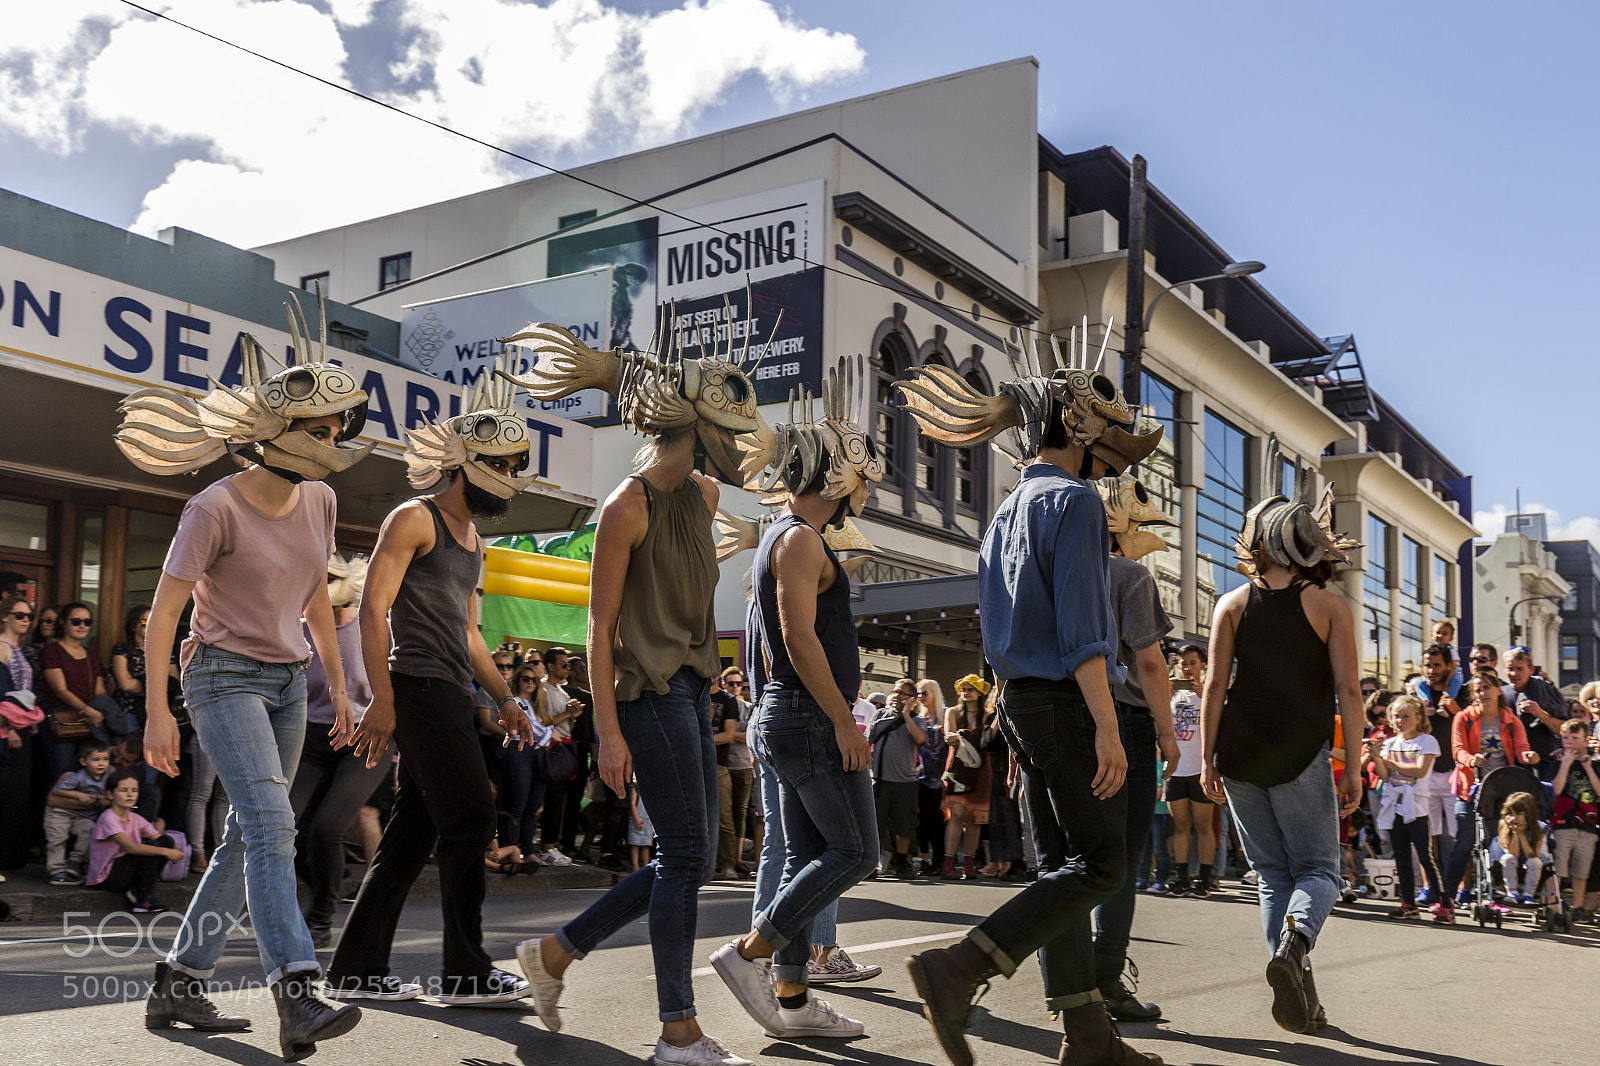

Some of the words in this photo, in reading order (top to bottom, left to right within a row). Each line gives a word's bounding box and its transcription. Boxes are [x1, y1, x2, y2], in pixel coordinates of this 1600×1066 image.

[667, 220, 796, 287] MISSING
[0, 280, 61, 338] N
[694, 307, 721, 326] SEEN
[748, 336, 805, 361] BREWERY.
[756, 364, 781, 381] HERE
[781, 362, 800, 377] FEB
[526, 398, 536, 409] &
[540, 396, 582, 412] Chips
